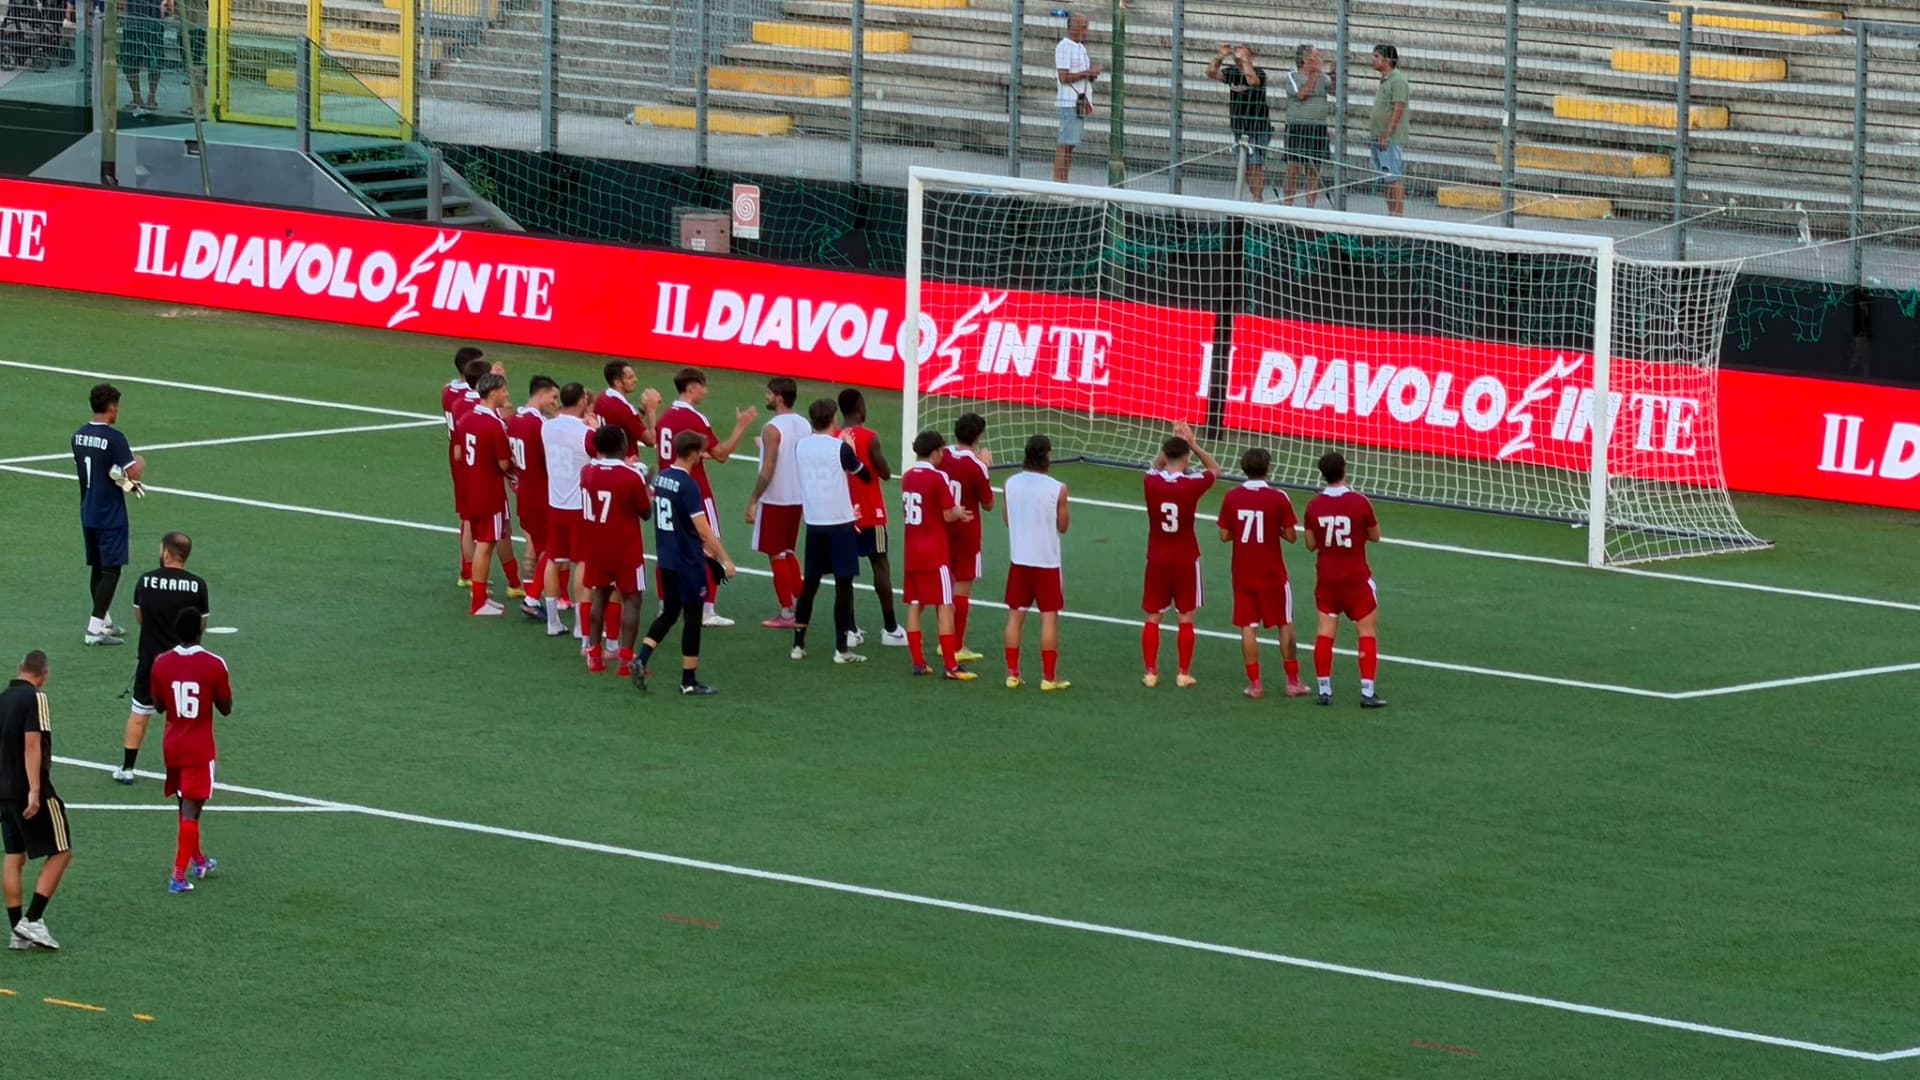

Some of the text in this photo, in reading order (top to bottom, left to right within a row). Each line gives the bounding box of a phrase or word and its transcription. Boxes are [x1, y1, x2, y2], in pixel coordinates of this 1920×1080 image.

[0, 207, 47, 261] TE
[135, 223, 177, 277] IL
[181, 231, 397, 302] DIAVOLO
[432, 259, 492, 313] IN
[496, 263, 555, 321] TE
[652, 281, 699, 338] IL
[702, 289, 938, 366] DIAVOLO
[978, 320, 1044, 377] IN
[1048, 325, 1112, 386] TE
[1250, 351, 1506, 432] DIAVOLO
[1551, 386, 1624, 443] IN
[1630, 391, 1700, 456] TE
[75, 434, 108, 451] TERAMO
[465, 432, 477, 467] 5
[660, 427, 673, 460] 6
[1817, 413, 1874, 476] IL
[84, 456, 92, 489] 1
[655, 496, 674, 531] 12
[902, 491, 922, 525] 36
[1160, 502, 1179, 533] 3
[1238, 509, 1264, 543] 71
[1318, 515, 1352, 548] 72
[143, 576, 199, 593] TERAMO
[171, 681, 200, 719] 16
